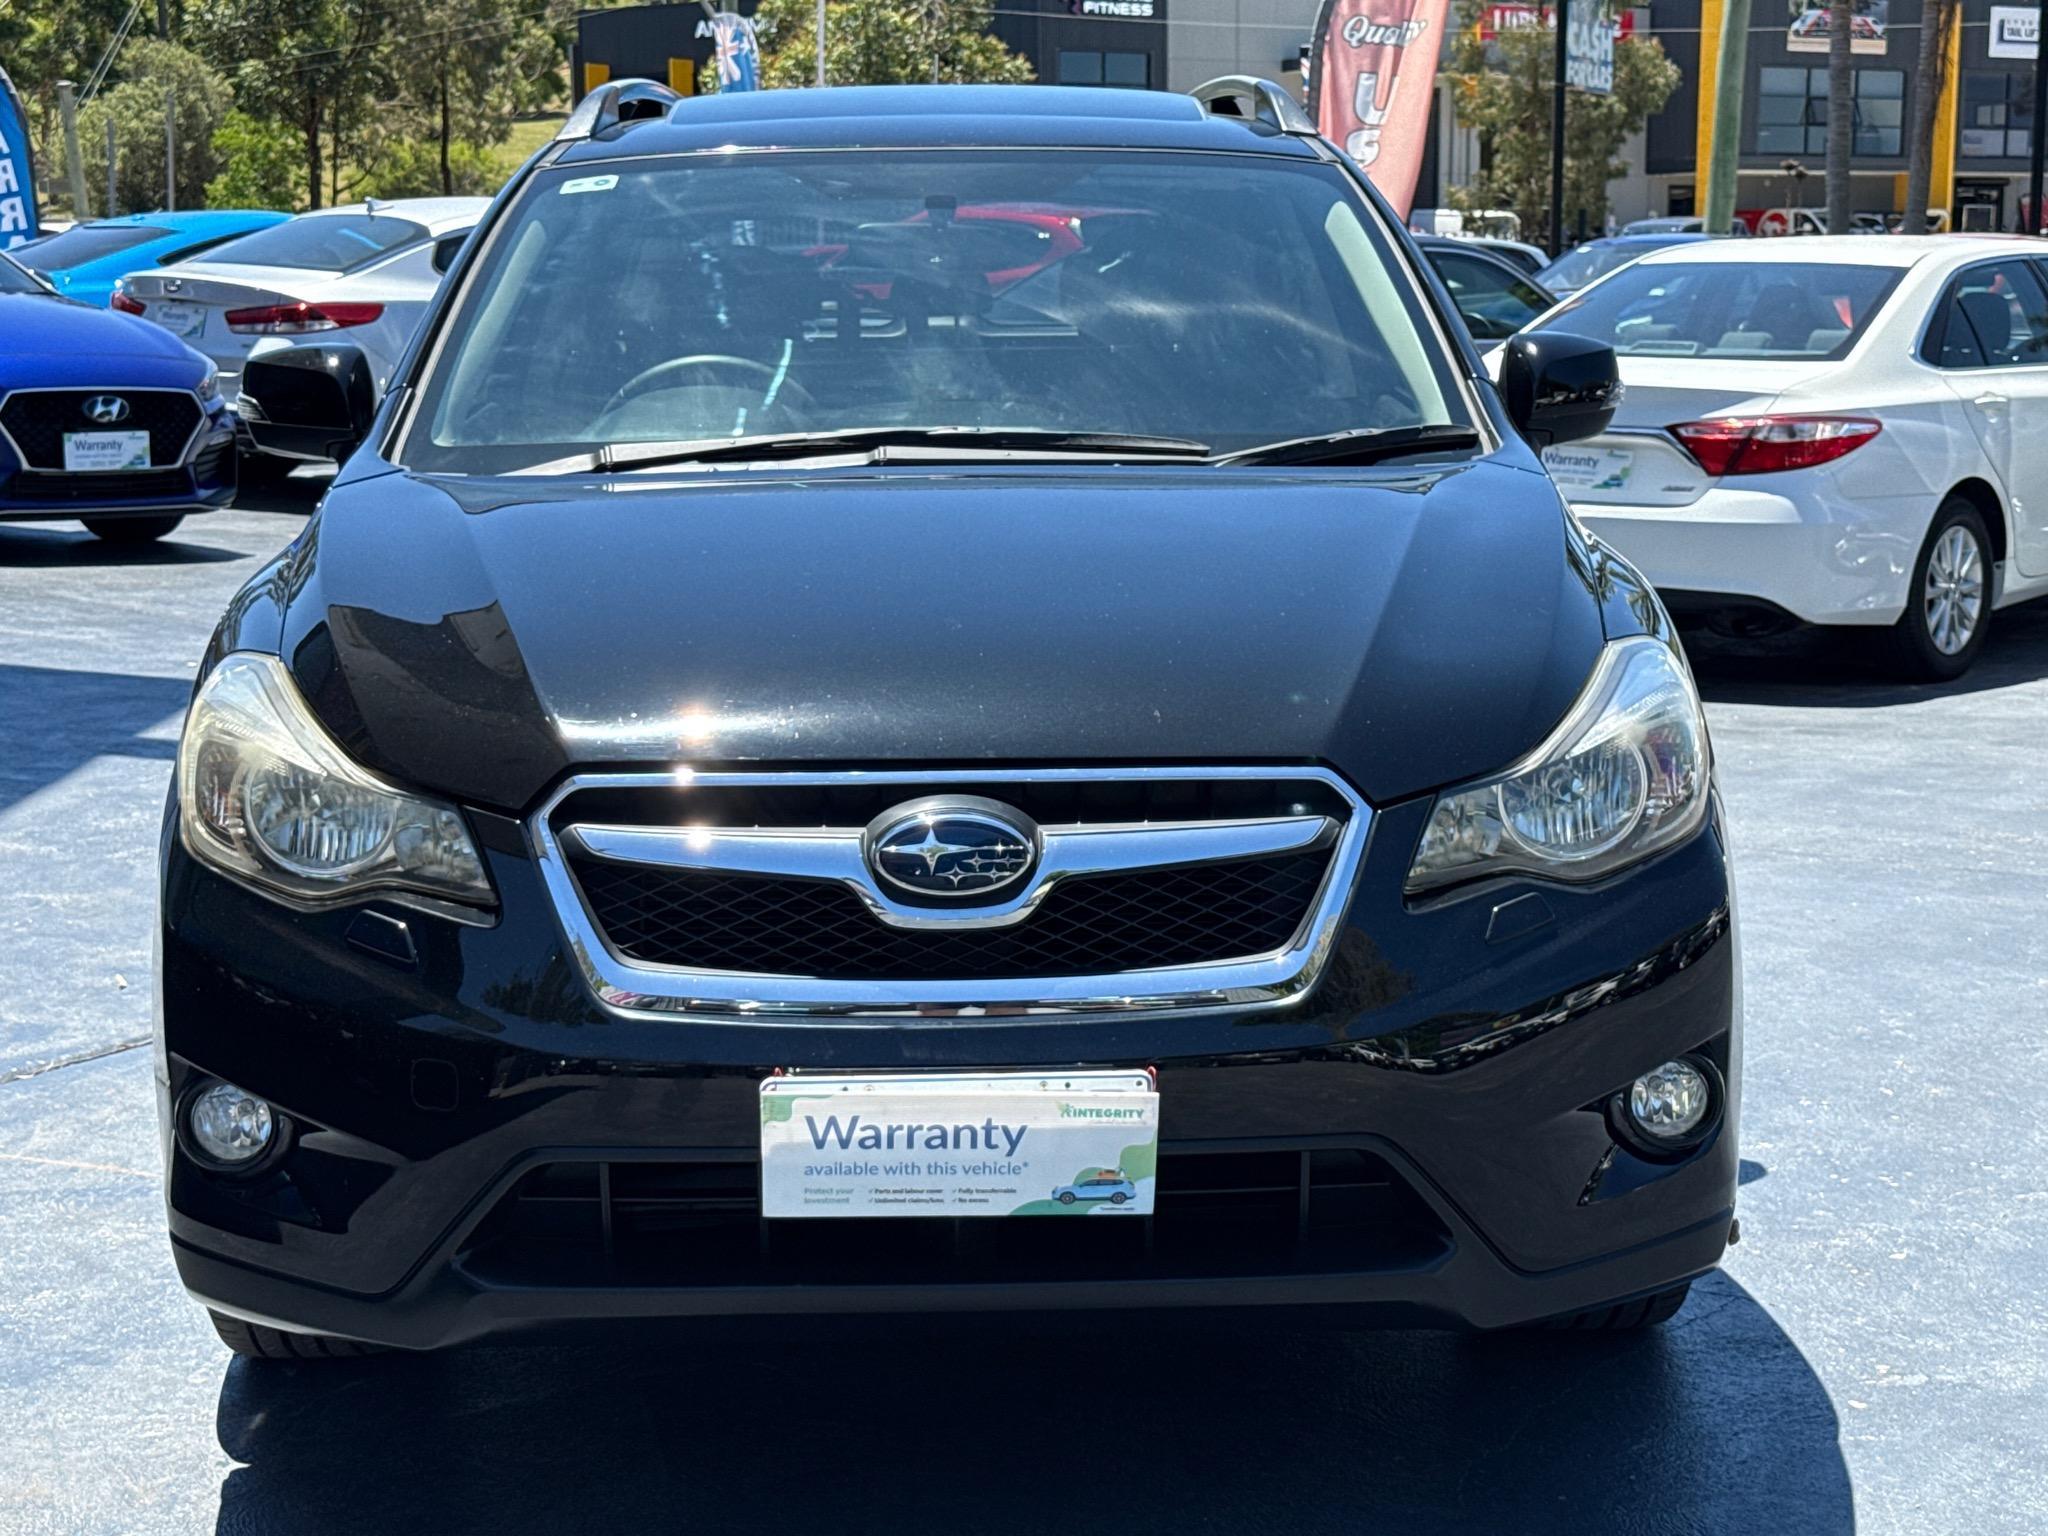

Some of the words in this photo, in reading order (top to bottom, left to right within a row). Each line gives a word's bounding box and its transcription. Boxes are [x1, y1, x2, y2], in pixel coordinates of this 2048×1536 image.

[1082, 1, 1153, 16] FITNESS
[1567, 20, 1613, 62] CASH
[74, 440, 124, 451] Warranty
[1544, 451, 1600, 469] Warranty
[1072, 1108, 1145, 1118] INTEGRITY
[804, 1115, 1028, 1157] Warranty
[804, 1162, 879, 1176] available
[884, 1162, 921, 1176] with
[927, 1162, 957, 1176] this
